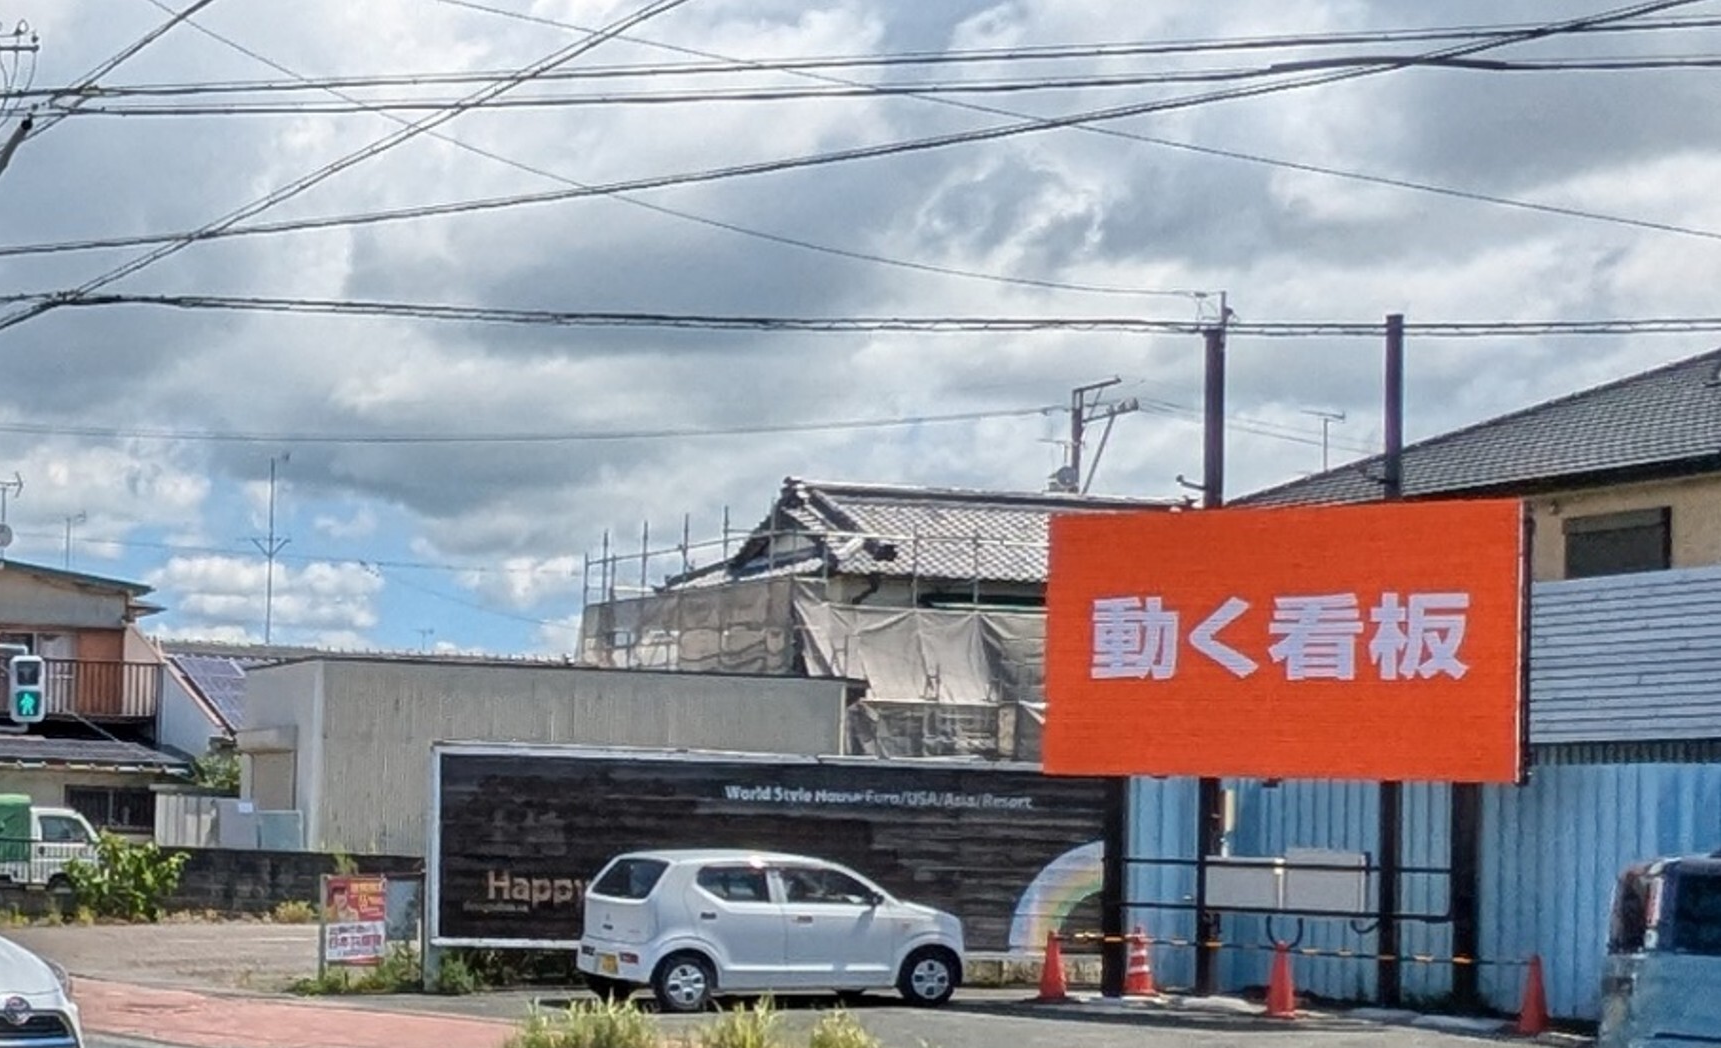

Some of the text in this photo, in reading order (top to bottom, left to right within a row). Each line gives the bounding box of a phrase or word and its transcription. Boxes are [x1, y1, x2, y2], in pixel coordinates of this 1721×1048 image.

[1091, 592, 1470, 681] 動く看板
[724, 785, 772, 801] World
[773, 786, 813, 803] Style
